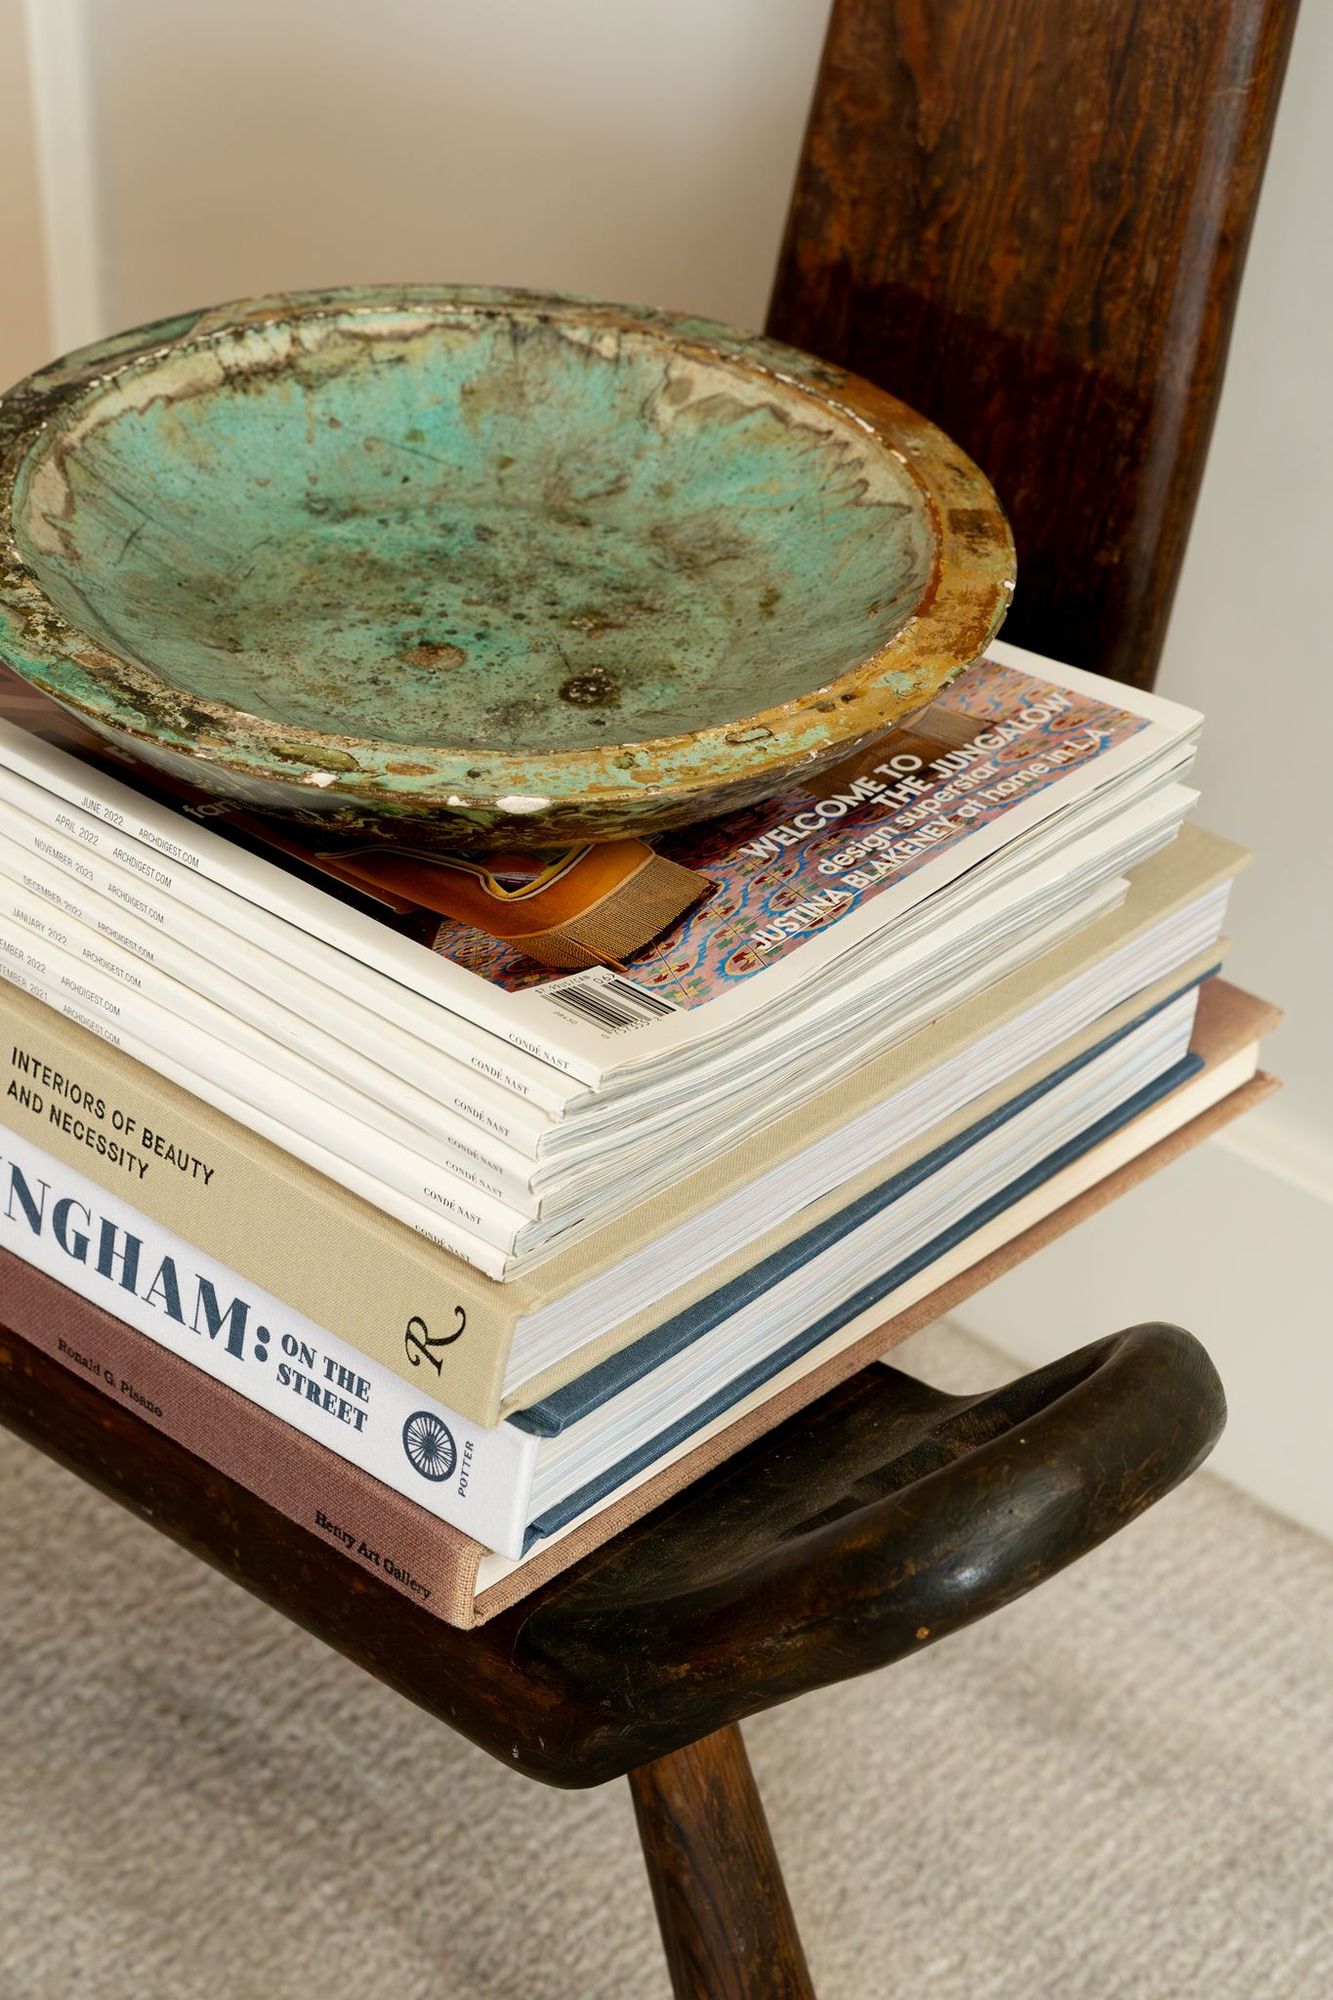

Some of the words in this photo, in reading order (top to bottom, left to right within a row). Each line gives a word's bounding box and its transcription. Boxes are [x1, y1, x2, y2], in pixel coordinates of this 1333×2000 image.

[870, 774, 934, 811] THE
[929, 692, 1073, 780] JUNGALOW
[80, 796, 102, 814] JUNE
[104, 808, 124, 827] 2022
[138, 828, 200, 868] ARCHDIGEST.COM
[740, 774, 887, 861] WELCOME
[873, 753, 923, 785] TO
[749, 888, 854, 953] JUSTINA
[841, 814, 955, 891] BLAKENEY
[957, 792, 989, 819] at
[979, 760, 1050, 803] home
[1044, 741, 1070, 764] in
[1071, 725, 1116, 754] L.A.
[816, 823, 899, 877] design
[895, 761, 1000, 829] superstar
[34, 837, 73, 867] NOVEMBER
[107, 883, 164, 924] ARCHDIGEST.COM
[55, 813, 76, 834] APRIL
[79, 827, 99, 846] 2022
[112, 847, 172, 888] ARCHDIGEST.COM
[12, 907, 45, 932] JANUARY
[48, 926, 67, 945] 2022
[82, 948, 142, 988] ARCHDIGEST.COM
[23, 875, 62, 905] DECEMBER
[97, 921, 154, 961] ARCHDIGEST.COM
[26, 955, 46, 974] 2022
[61, 976, 120, 1016] ARCHDIGEST.COM
[63, 1004, 121, 1045] ARCHDIGEST.COM
[508, 1033, 541, 1059] CONDÉ
[543, 1047, 570, 1070] NAST
[470, 1057, 504, 1084] CONDÉ
[503, 1071, 530, 1096] NAST
[7, 1080, 43, 1114] AND
[49, 1104, 150, 1180] NECESSITY
[11, 1046, 106, 1120] INTERIORS
[111, 1107, 137, 1138] OF
[141, 1125, 215, 1186] BEAUTY
[454, 1098, 486, 1123] CONDÉ
[485, 1113, 511, 1137] NAST
[478, 1175, 504, 1198] NAST
[479, 1152, 505, 1175] NAST
[423, 1187, 456, 1211] CONDÉ
[456, 1201, 483, 1225] NAST
[0, 1156, 271, 1363] NGHAM:
[445, 1241, 472, 1263] NAST
[281, 1333, 317, 1369] ON
[323, 1355, 371, 1404] THE
[405, 1304, 467, 1377] R
[57, 1337, 101, 1376] Ronald
[103, 1369, 117, 1388] G.
[119, 1380, 164, 1418] Pisano
[276, 1362, 369, 1433] STREET
[457, 1439, 475, 1498] POTTER
[315, 1509, 356, 1549] Henry
[357, 1541, 381, 1566] Art
[383, 1557, 431, 1600] Gallery
